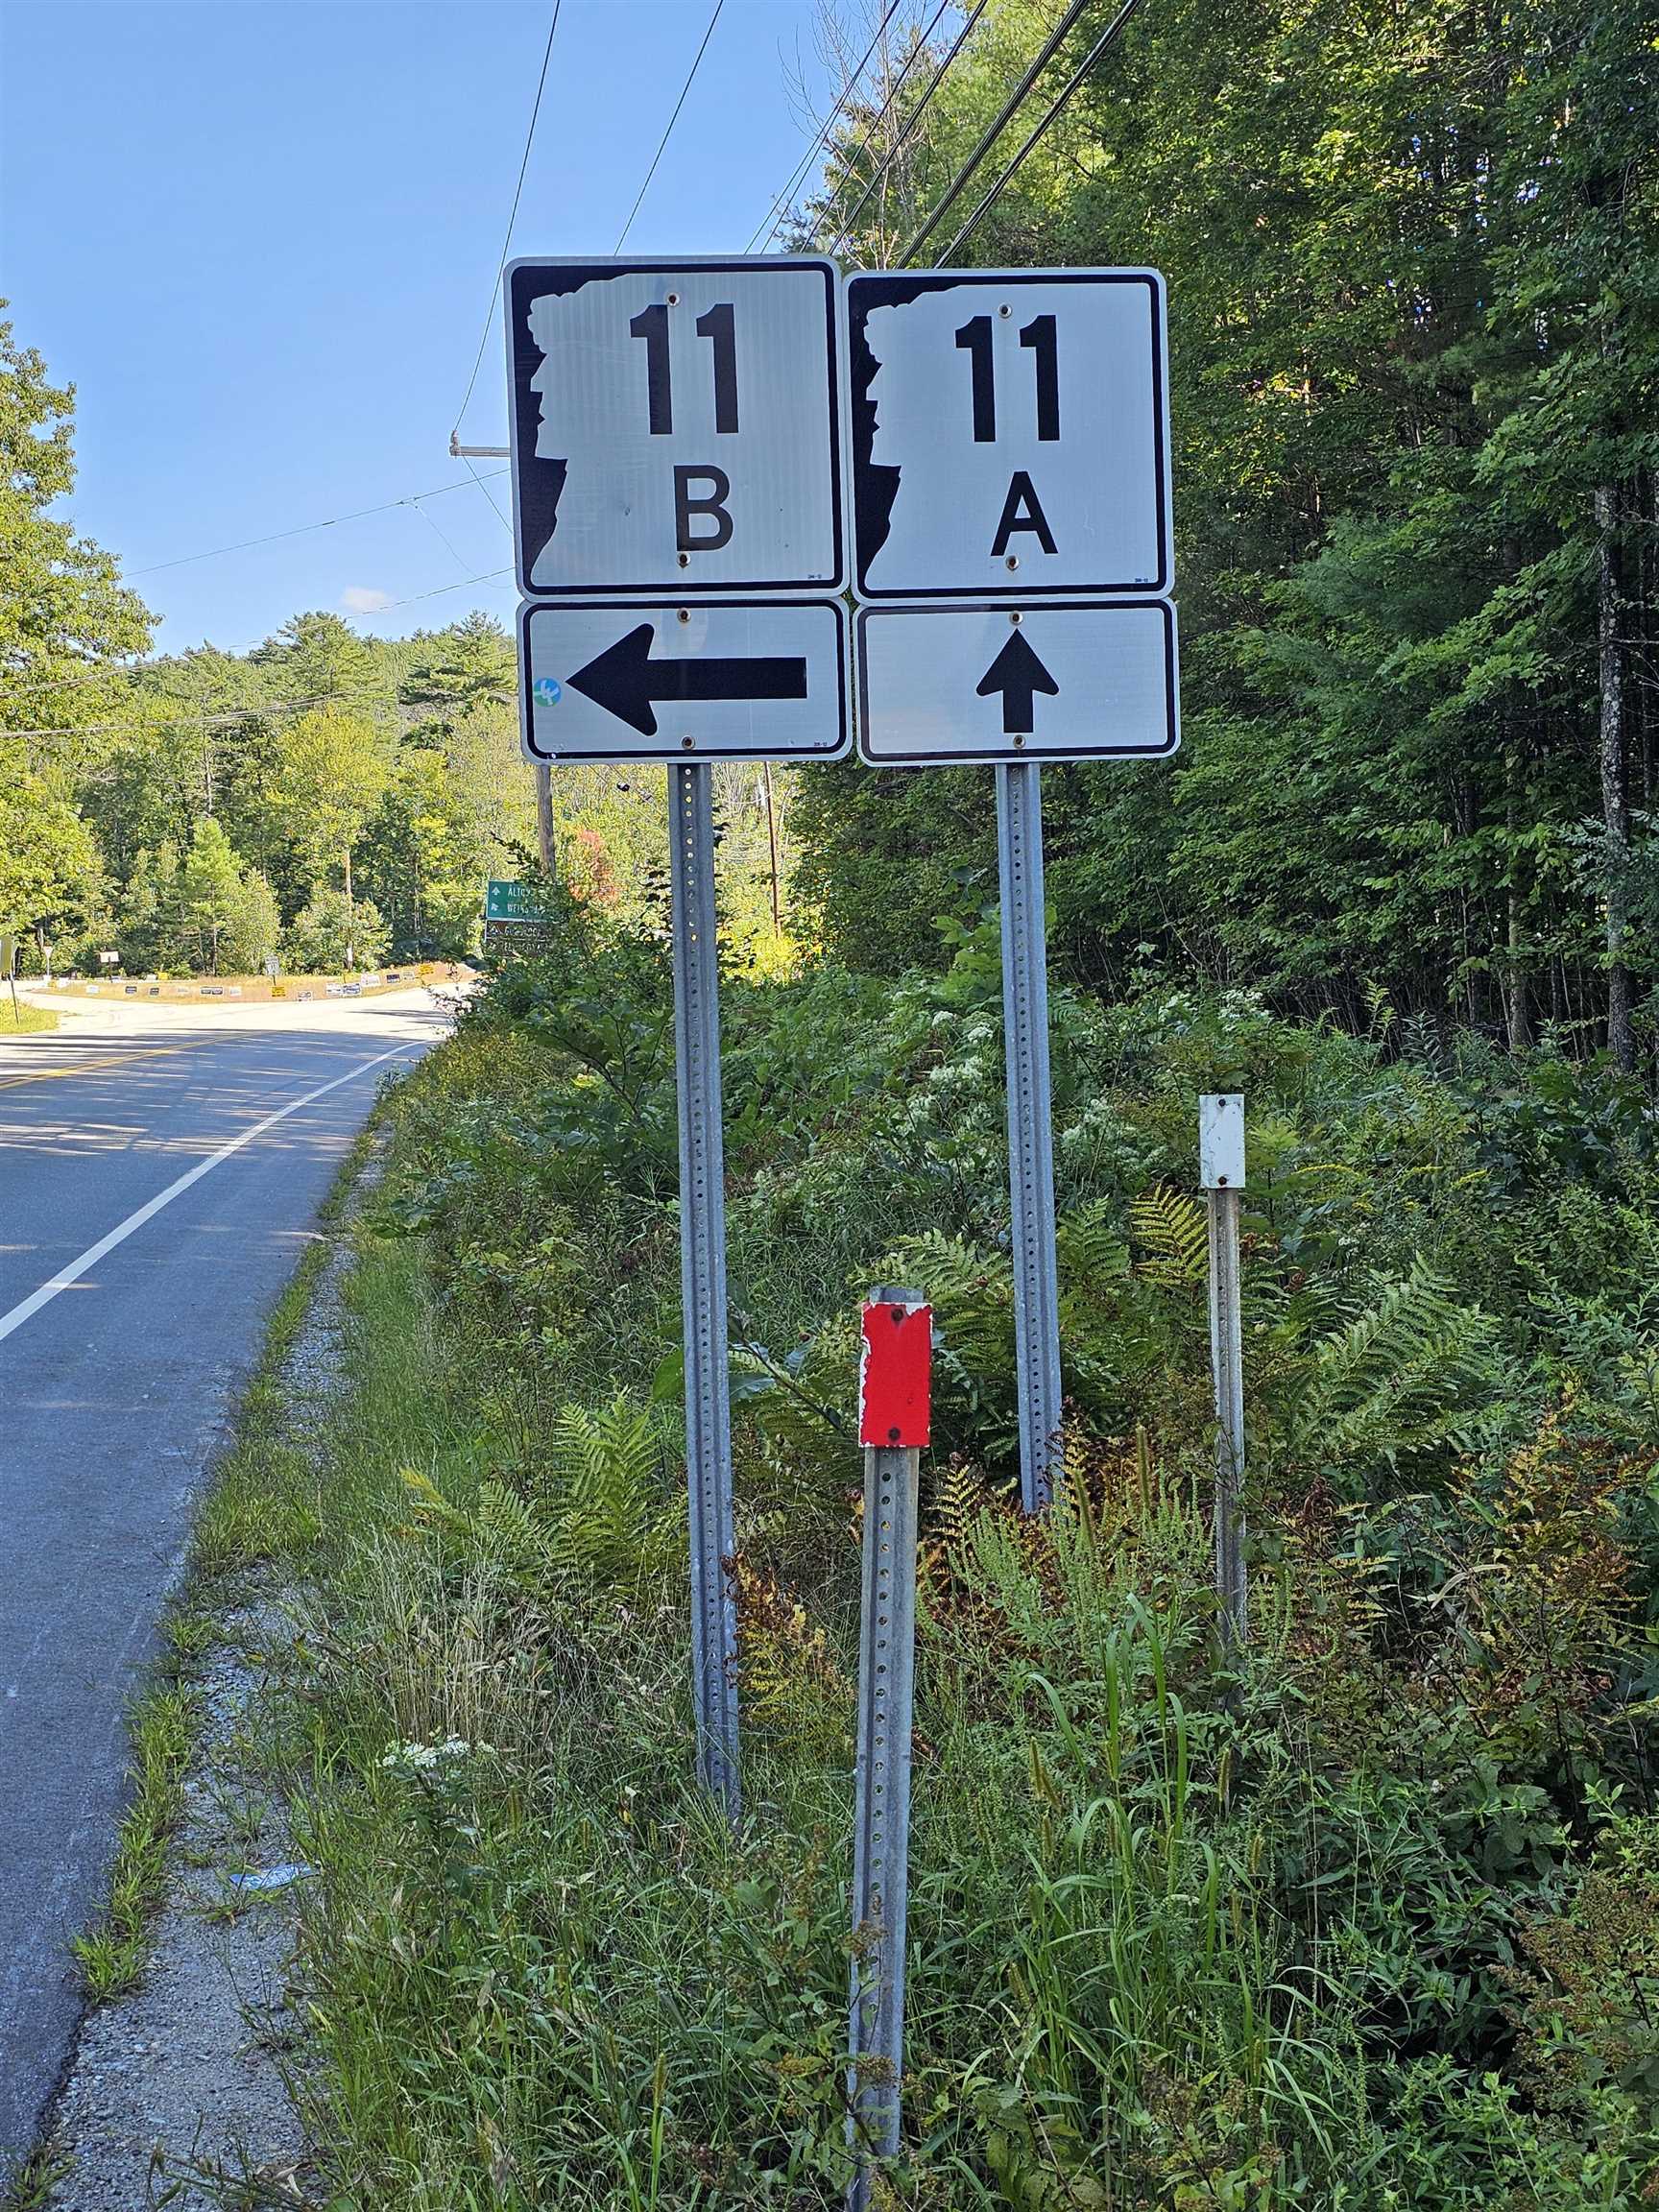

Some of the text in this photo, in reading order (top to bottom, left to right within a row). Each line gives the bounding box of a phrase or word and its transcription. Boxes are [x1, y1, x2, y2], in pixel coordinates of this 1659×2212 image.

[630, 303, 739, 435] 11
[954, 315, 1060, 443] 11
[673, 465, 733, 552] B
[990, 470, 1059, 557] A
